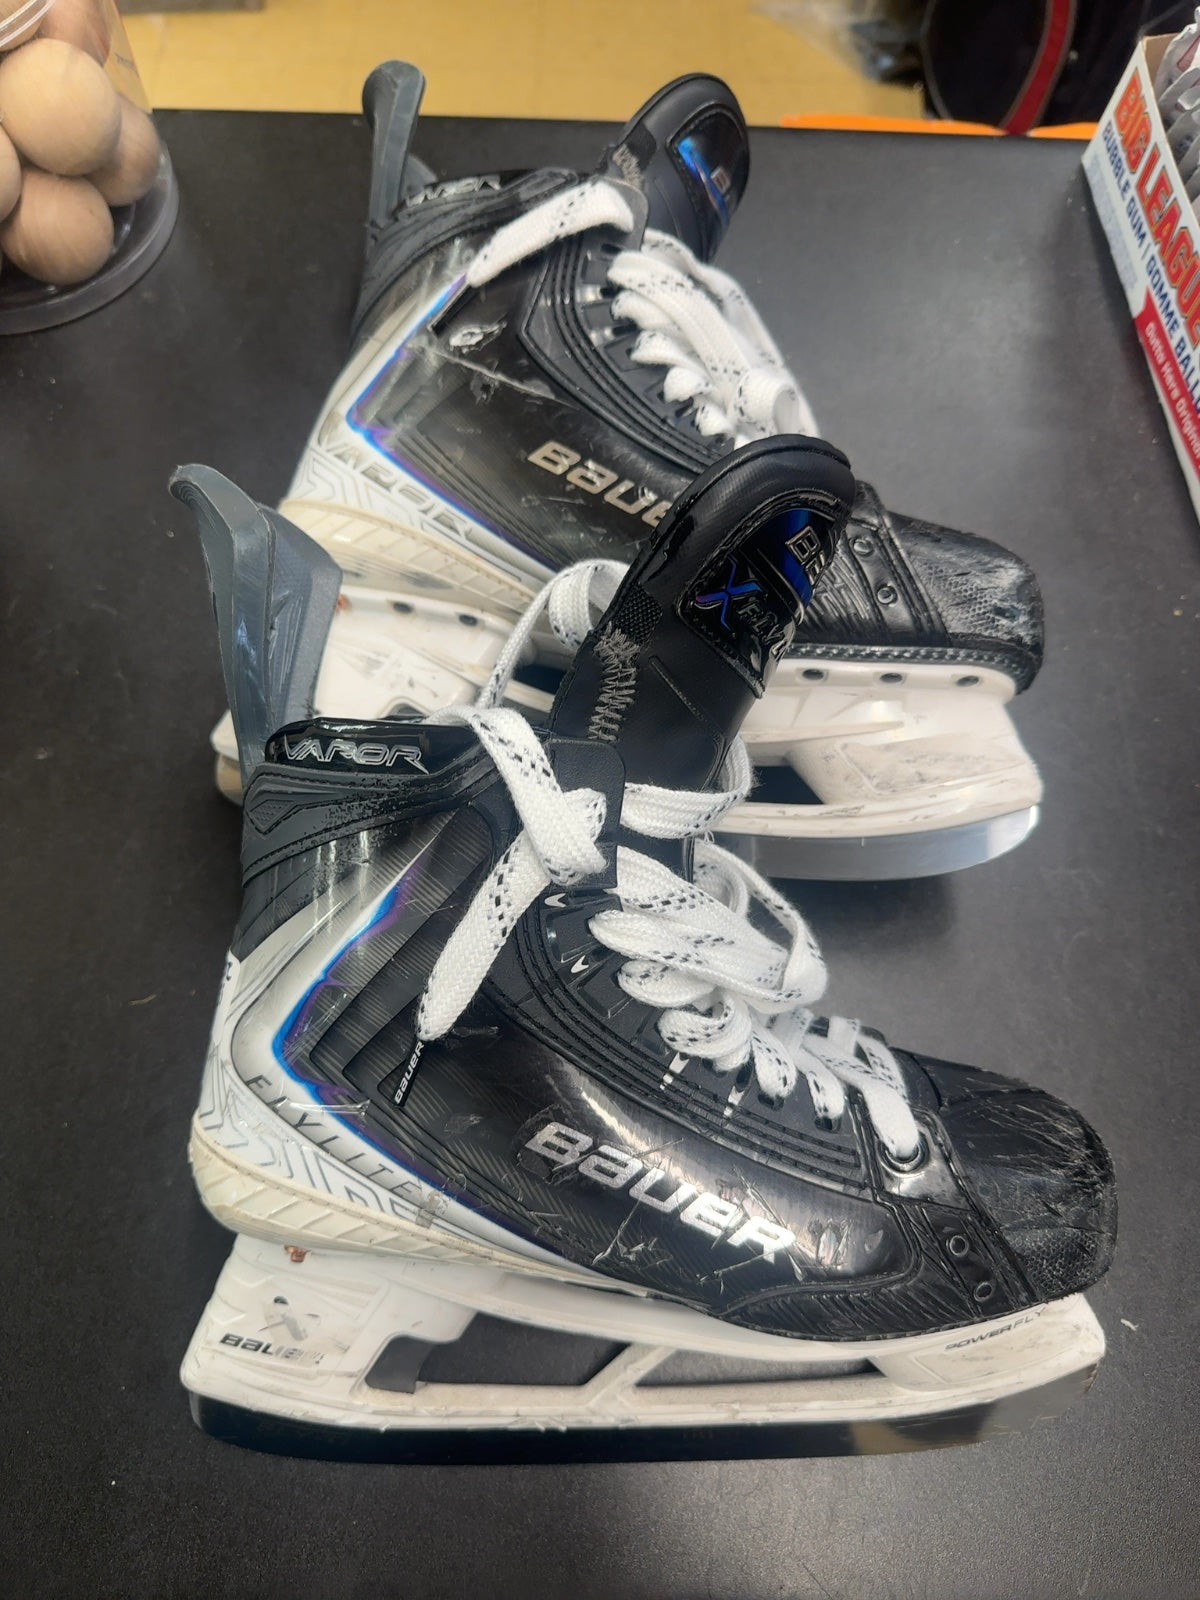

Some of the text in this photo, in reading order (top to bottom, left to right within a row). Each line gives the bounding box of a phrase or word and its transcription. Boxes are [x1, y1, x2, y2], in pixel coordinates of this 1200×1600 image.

[1114, 66, 1153, 174] BIG
[1102, 121, 1132, 201] BUBBLE
[1126, 196, 1147, 249] GUM
[1146, 254, 1181, 340] GOMME
[283, 734, 430, 775] VAPOR
[245, 1073, 423, 1200] FLYLITE
[944, 1306, 1047, 1351] POWERFLY
